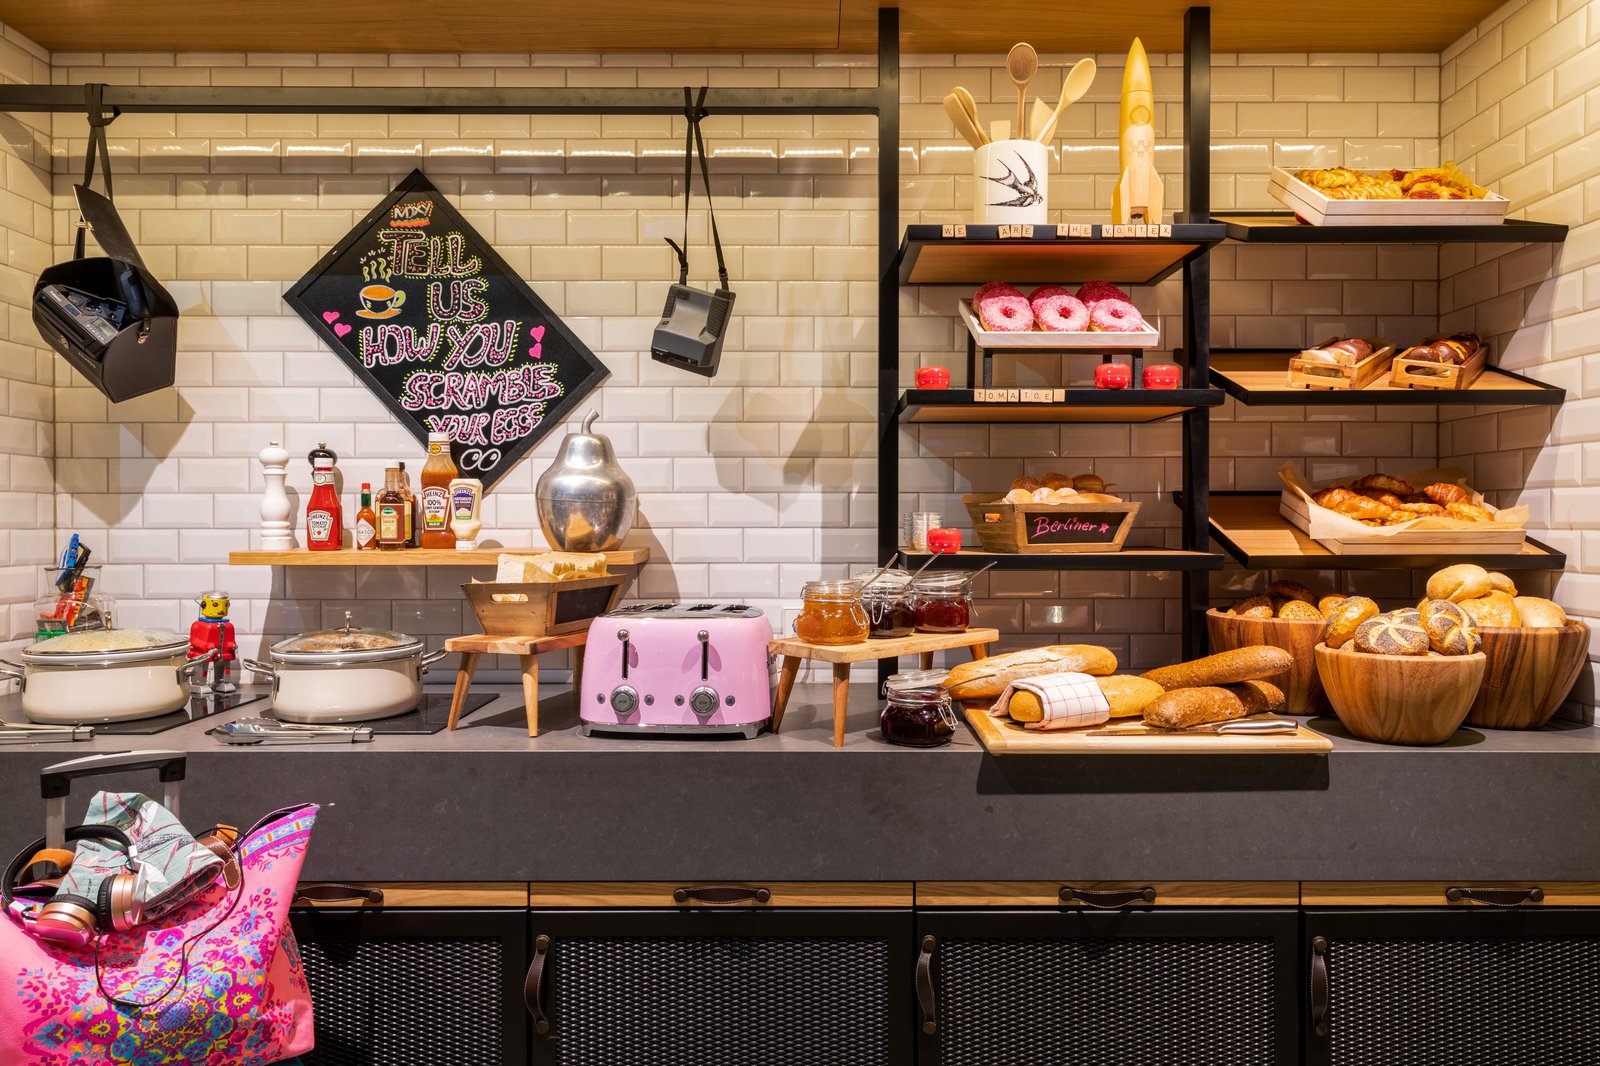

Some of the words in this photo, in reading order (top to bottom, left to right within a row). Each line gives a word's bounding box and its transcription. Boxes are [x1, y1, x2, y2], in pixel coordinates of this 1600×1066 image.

[394, 202, 431, 219] MOXY
[944, 227, 965, 236] WE
[1001, 226, 1031, 236] ARE
[1060, 226, 1090, 236] THE
[1104, 226, 1170, 236] VORTEX
[380, 230, 478, 276] TELL
[431, 279, 486, 321] US
[363, 323, 441, 369] HOW
[444, 320, 516, 371] YOU
[402, 365, 561, 411] SCRAMBLE
[977, 391, 1052, 401] TOMATOE
[428, 412, 491, 446] YOUR
[1031, 516, 1098, 539] Berliner
